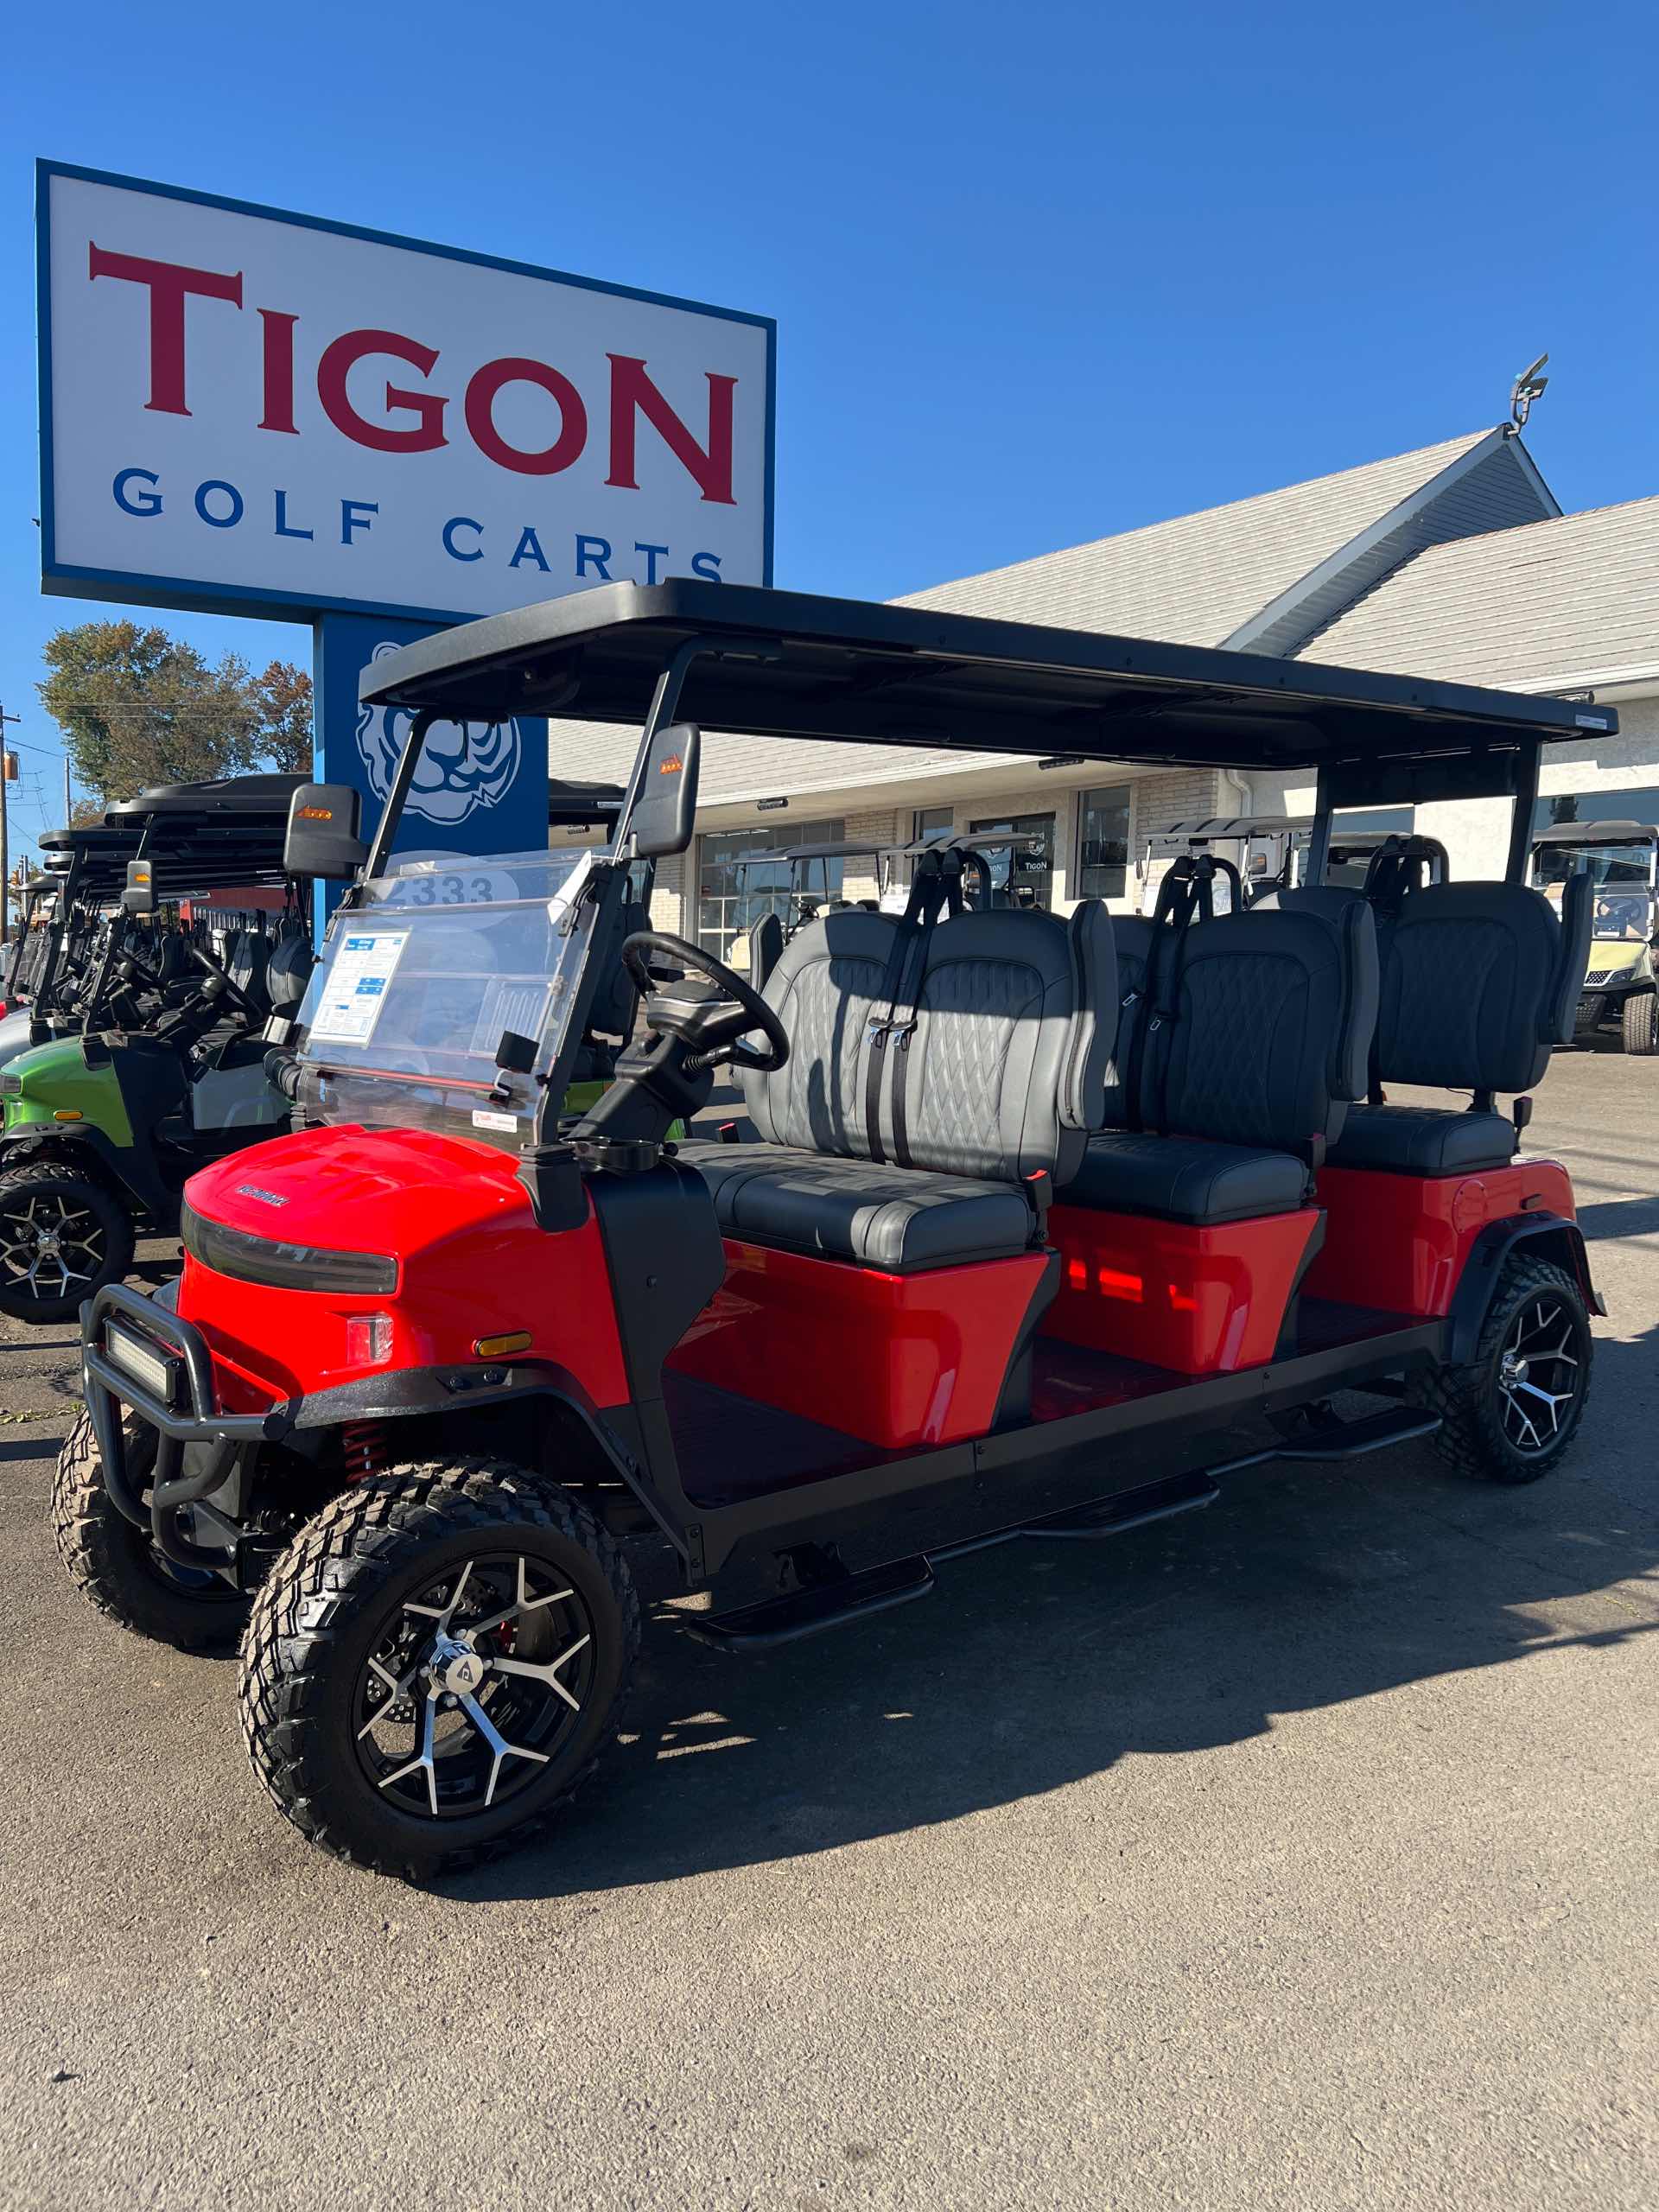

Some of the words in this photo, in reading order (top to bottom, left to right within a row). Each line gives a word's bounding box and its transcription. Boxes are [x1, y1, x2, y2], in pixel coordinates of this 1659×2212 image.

[90, 241, 738, 506] TIGON
[113, 468, 379, 546] GOLF
[442, 518, 722, 586] CARTS
[1025, 861, 1047, 870] TIGON
